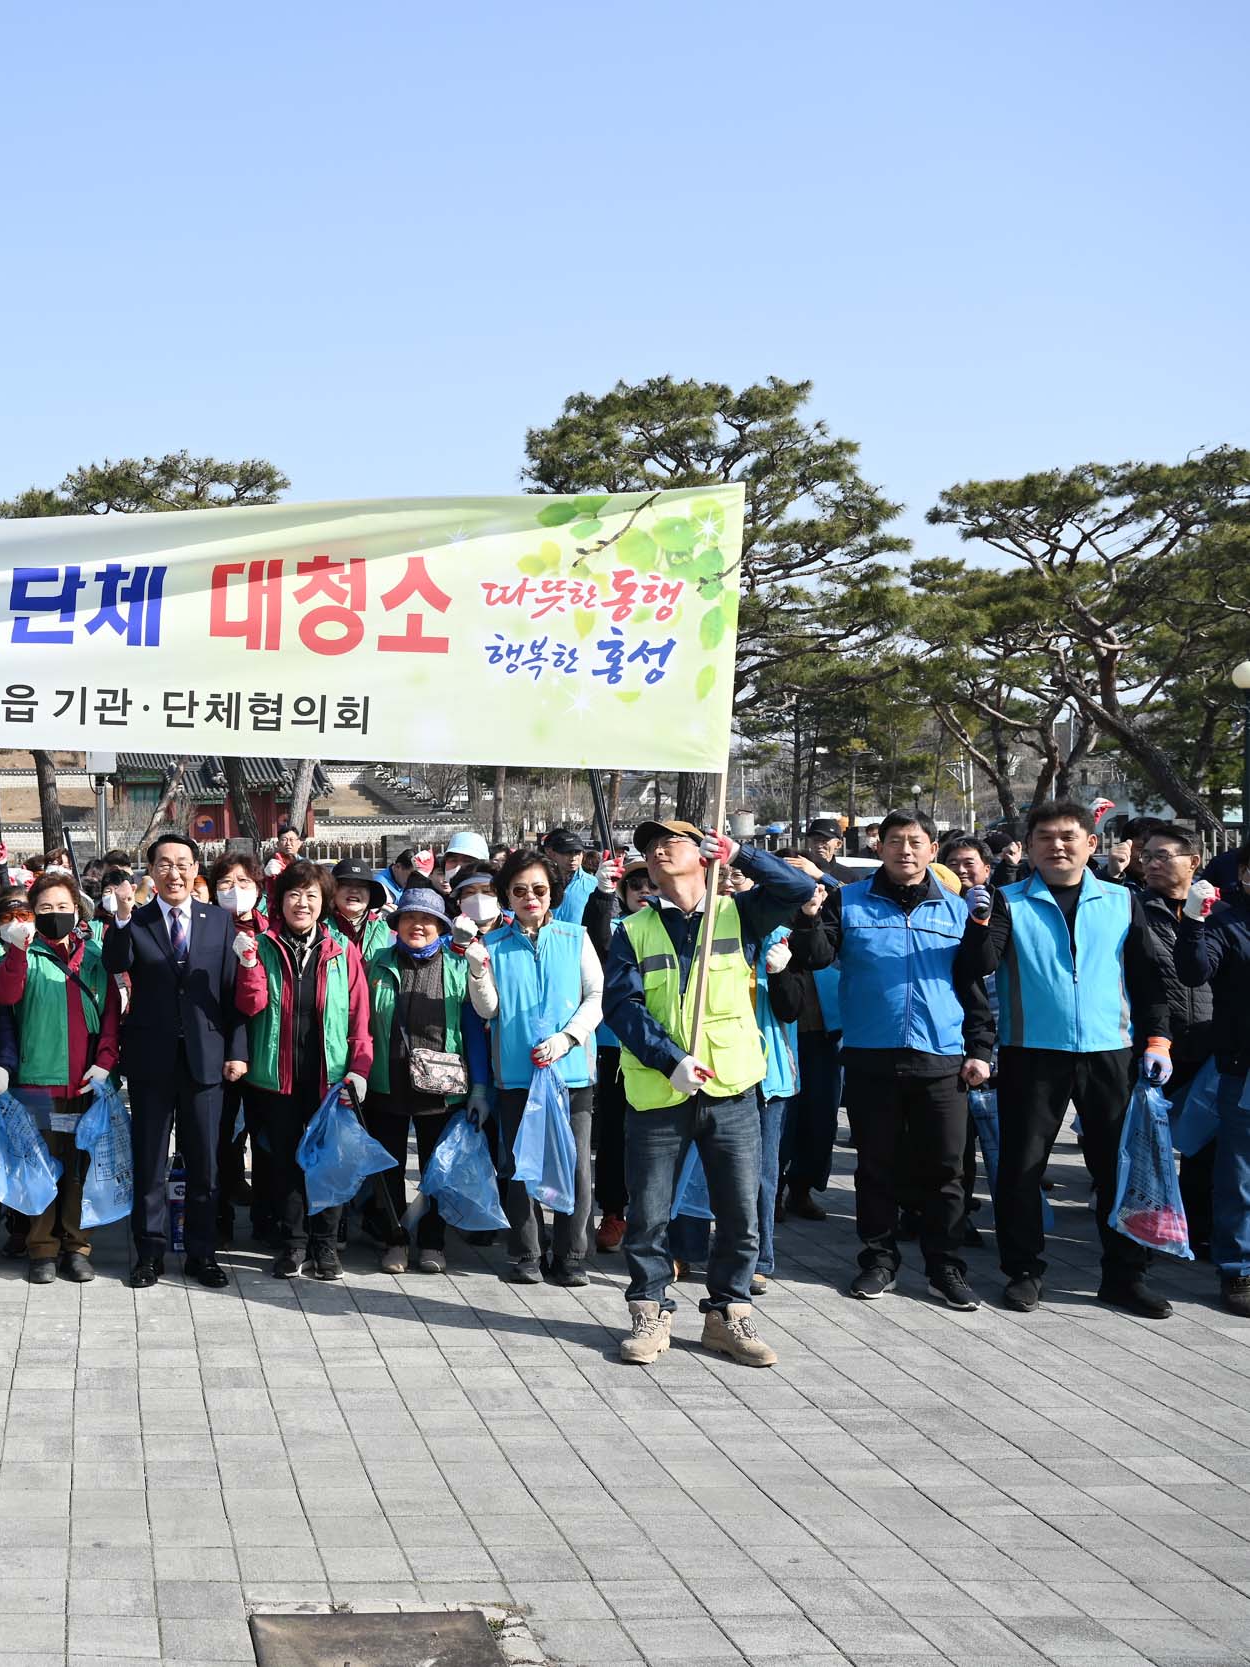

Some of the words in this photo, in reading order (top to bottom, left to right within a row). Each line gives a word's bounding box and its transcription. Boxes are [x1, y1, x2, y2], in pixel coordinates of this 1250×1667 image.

[209, 555, 452, 656] 대청소
[481, 577, 597, 619] 따뜻한
[600, 569, 685, 622] 동행
[485, 633, 579, 681] 행복한
[591, 625, 677, 685] 홍성
